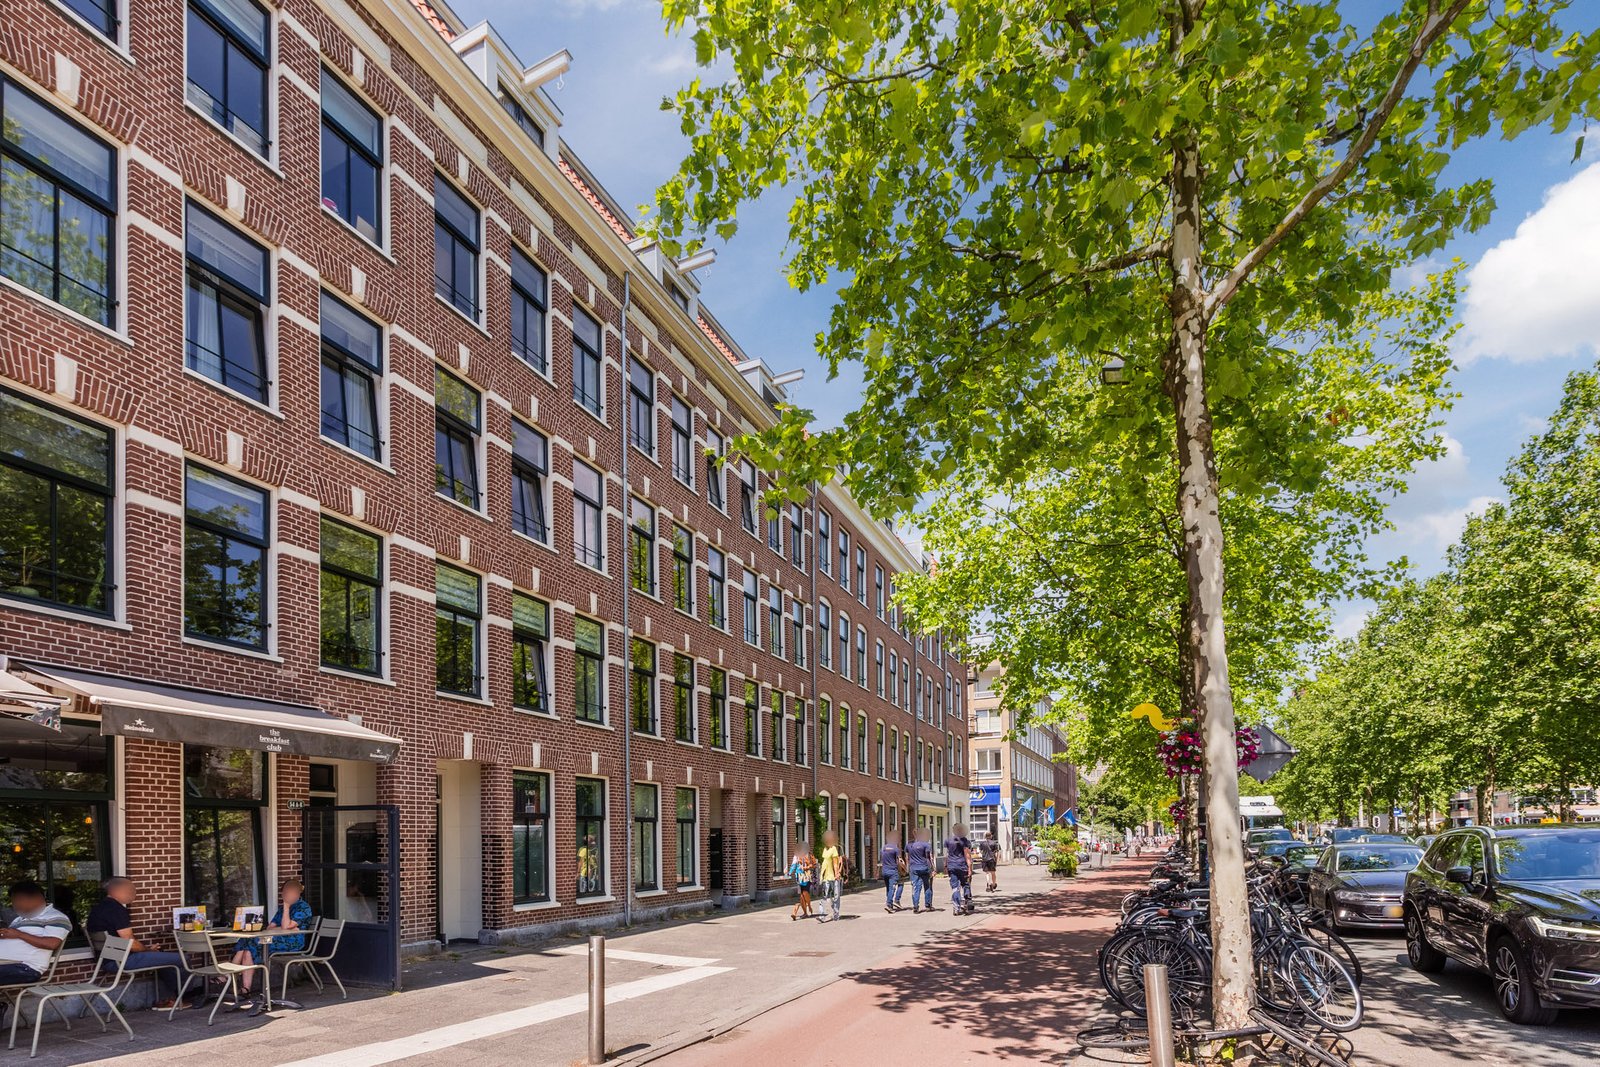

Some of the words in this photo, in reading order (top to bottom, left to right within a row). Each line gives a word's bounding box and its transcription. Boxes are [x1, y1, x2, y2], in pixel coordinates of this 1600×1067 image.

[269, 728, 280, 737] the
[259, 734, 290, 745] breakfast
[266, 743, 282, 752] club
